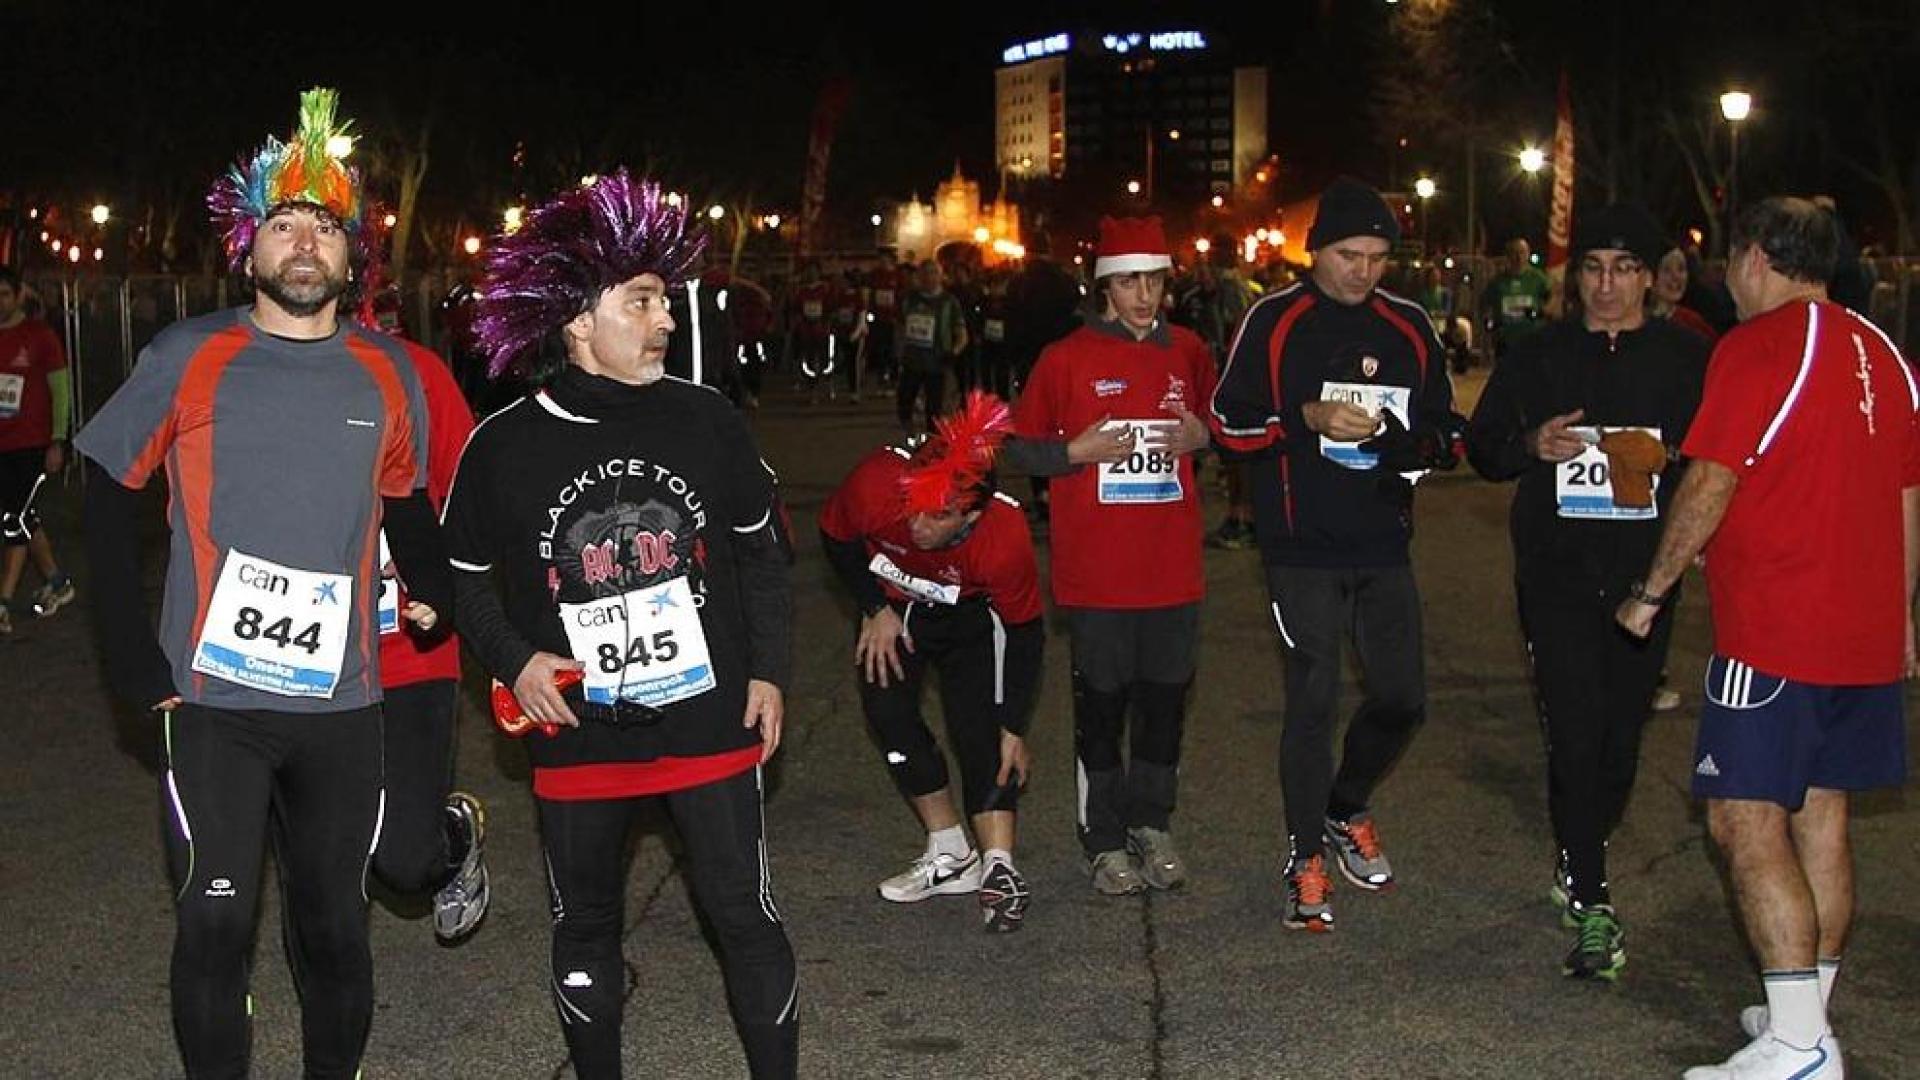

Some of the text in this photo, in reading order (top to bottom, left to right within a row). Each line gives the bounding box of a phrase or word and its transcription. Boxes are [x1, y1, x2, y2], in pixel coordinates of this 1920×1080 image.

[1149, 31, 1205, 50] HOTEL
[538, 459, 707, 560] BLACK ICE TOUR
[238, 563, 290, 596] can
[233, 606, 322, 655] 844
[577, 604, 628, 628] can
[597, 629, 680, 674] 845
